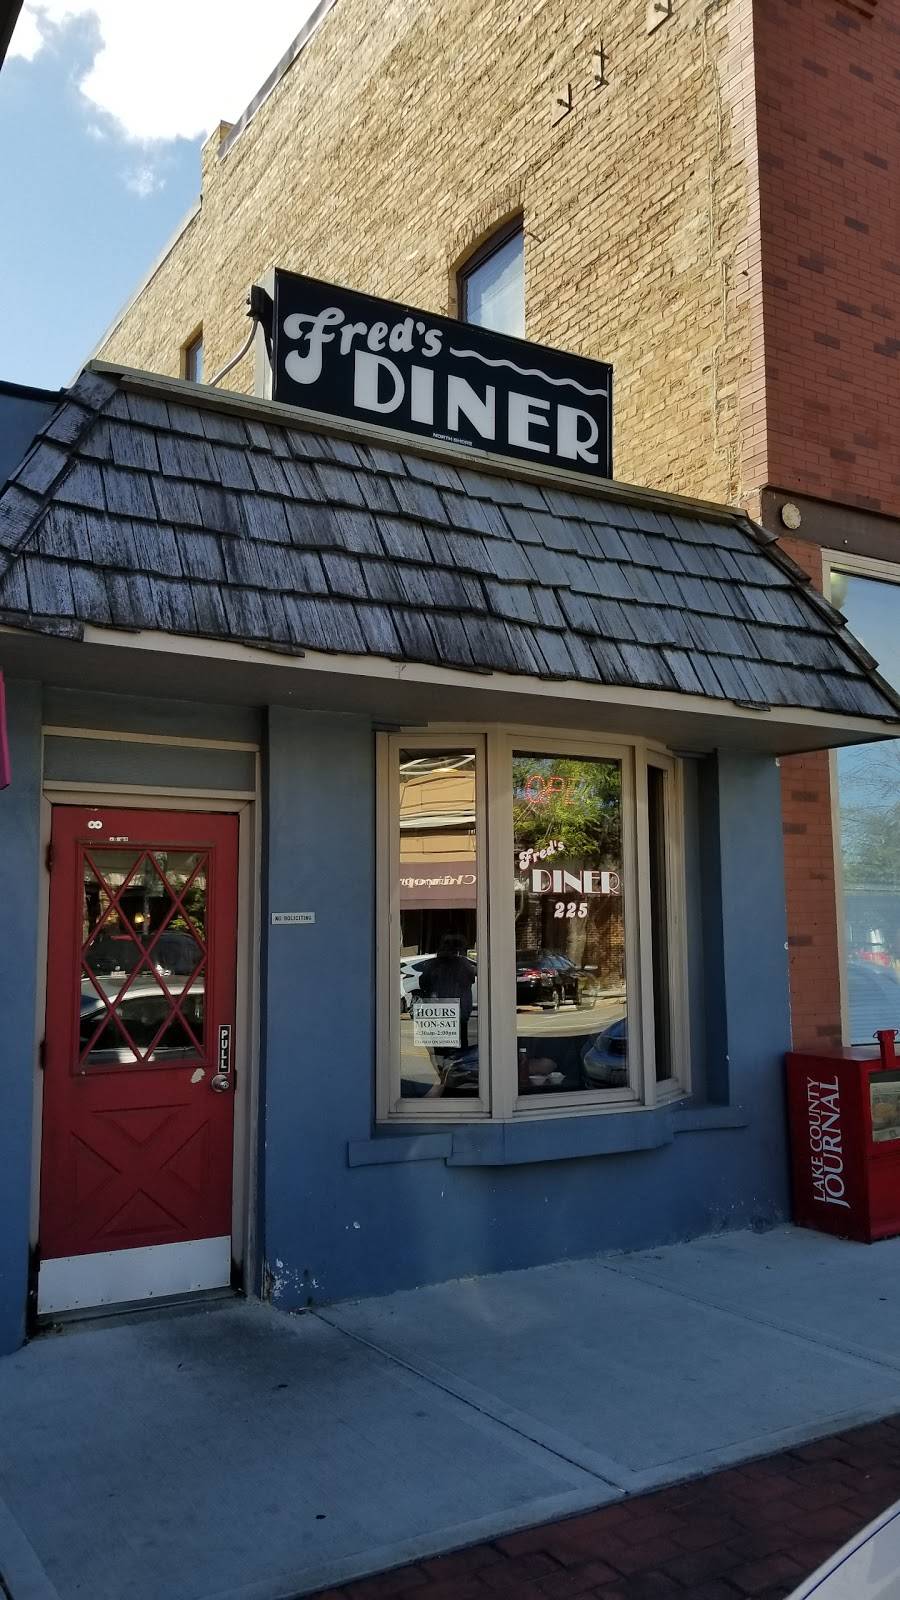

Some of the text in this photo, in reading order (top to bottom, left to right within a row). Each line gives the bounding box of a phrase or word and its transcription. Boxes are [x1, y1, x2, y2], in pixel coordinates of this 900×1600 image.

[283, 306, 443, 385] Fred's
[353, 349, 600, 464] DINER
[518, 839, 565, 870] Fred's
[532, 869, 620, 895] DINER
[553, 901, 588, 919] 225
[415, 1020, 457, 1028] MON-SAT
[416, 1007, 456, 1017] HOURS
[221, 1030, 229, 1069] PULL
[807, 1076, 826, 1202] LAKE COUNTY
[820, 1075, 850, 1208] JOURNAL
